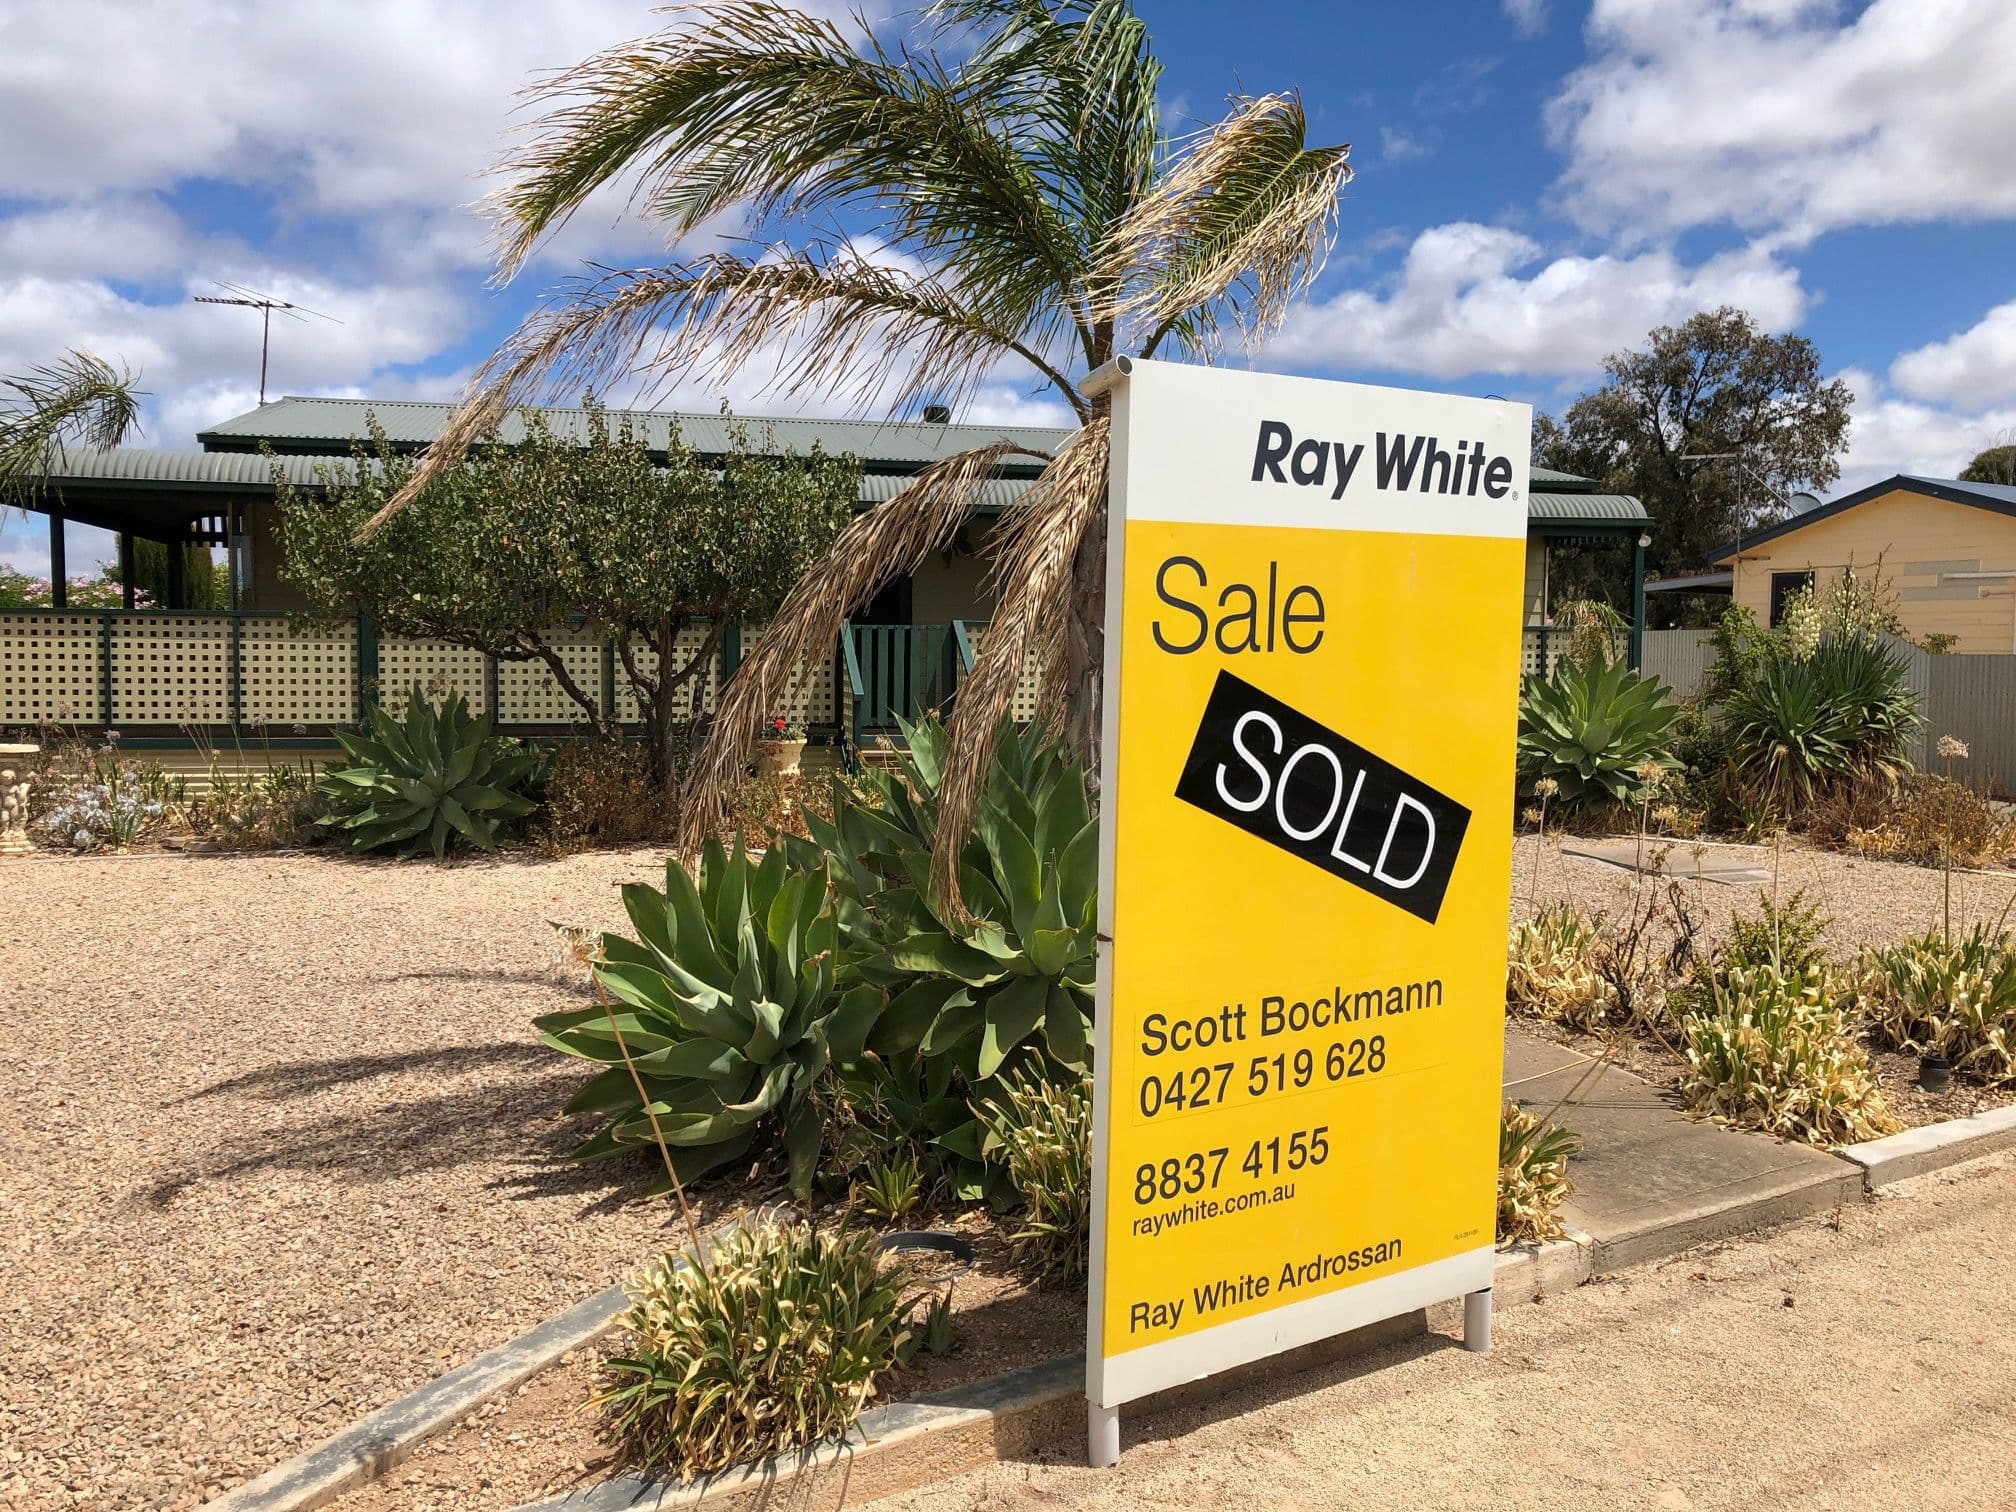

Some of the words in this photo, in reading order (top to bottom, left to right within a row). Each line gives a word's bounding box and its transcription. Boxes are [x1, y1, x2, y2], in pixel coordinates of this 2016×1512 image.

[1251, 420, 1364, 500] Ray
[1375, 432, 1513, 499] White
[1152, 556, 1325, 655] Sale
[1215, 710, 1436, 889] SOLD
[1141, 1004, 1247, 1056] Scott
[1260, 980, 1443, 1037] Bockmann
[1140, 1062, 1234, 1117] 0427
[1247, 1049, 1313, 1097] 519
[1325, 1035, 1386, 1082] 628
[1134, 1148, 1229, 1204] 8837
[1242, 1126, 1329, 1179] 4155
[1132, 1182, 1295, 1236] raywhite.com.au
[1130, 1298, 1184, 1333] Ray
[1193, 1275, 1269, 1314] White
[1277, 1238, 1402, 1292] Ardrossan
